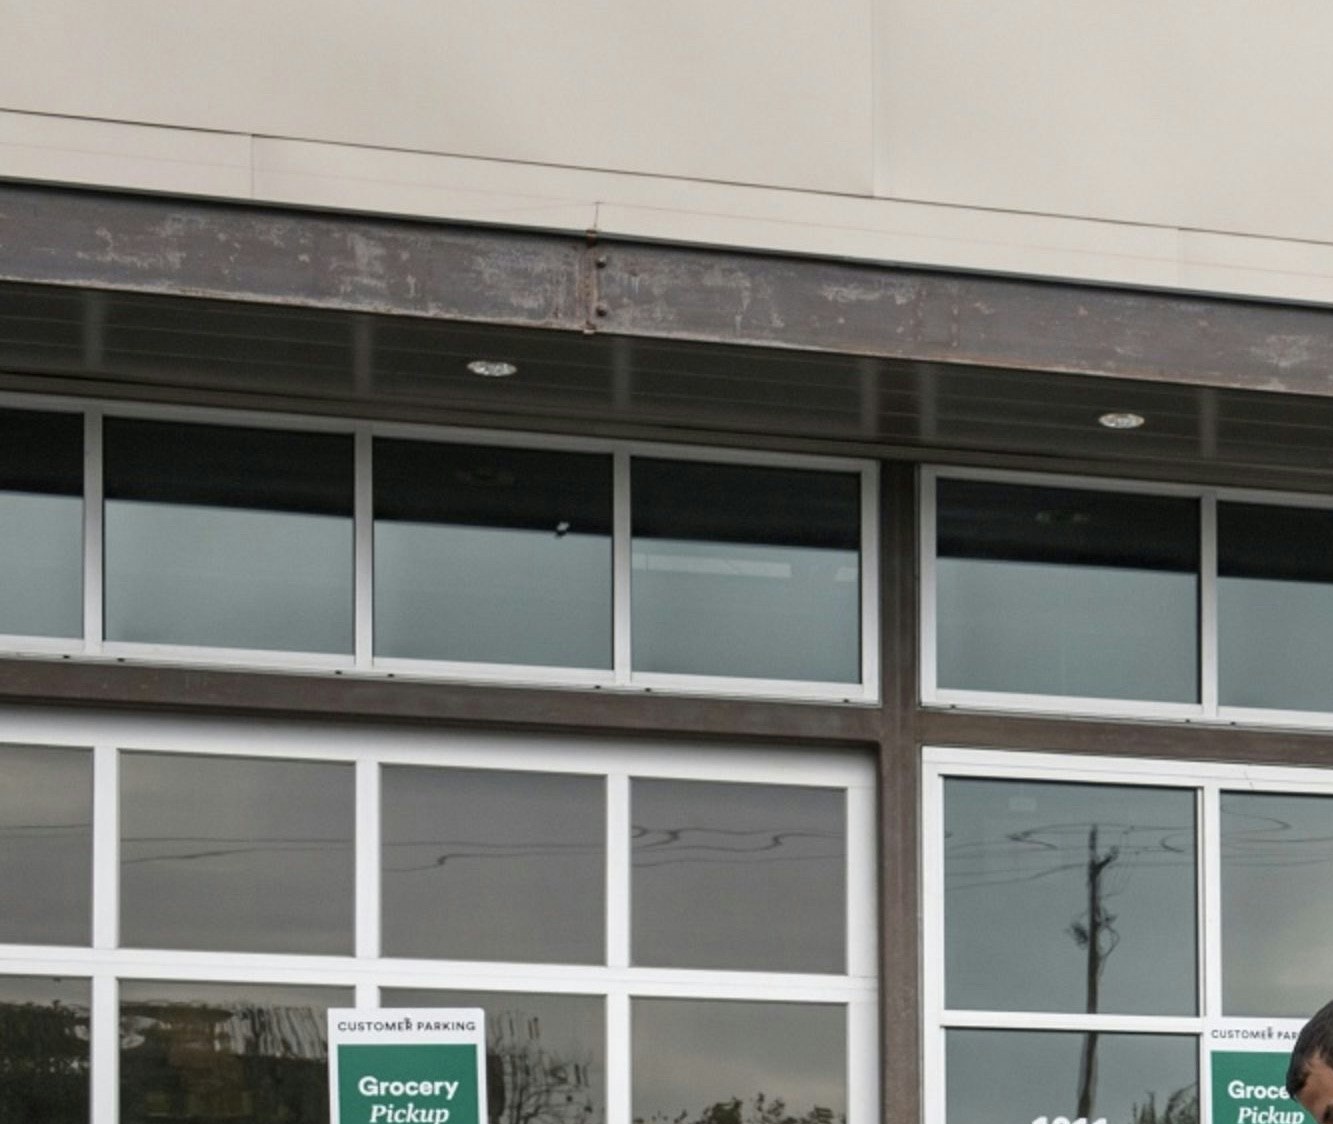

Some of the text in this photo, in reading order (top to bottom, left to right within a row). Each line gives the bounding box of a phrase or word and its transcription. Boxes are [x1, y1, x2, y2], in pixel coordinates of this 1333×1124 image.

[337, 1020, 476, 1032] CUSTOMER PARKING
[1211, 1028, 1273, 1040] CUSTOMER
[357, 1076, 459, 1099] Grocery
[1227, 1080, 1288, 1100] Groce
